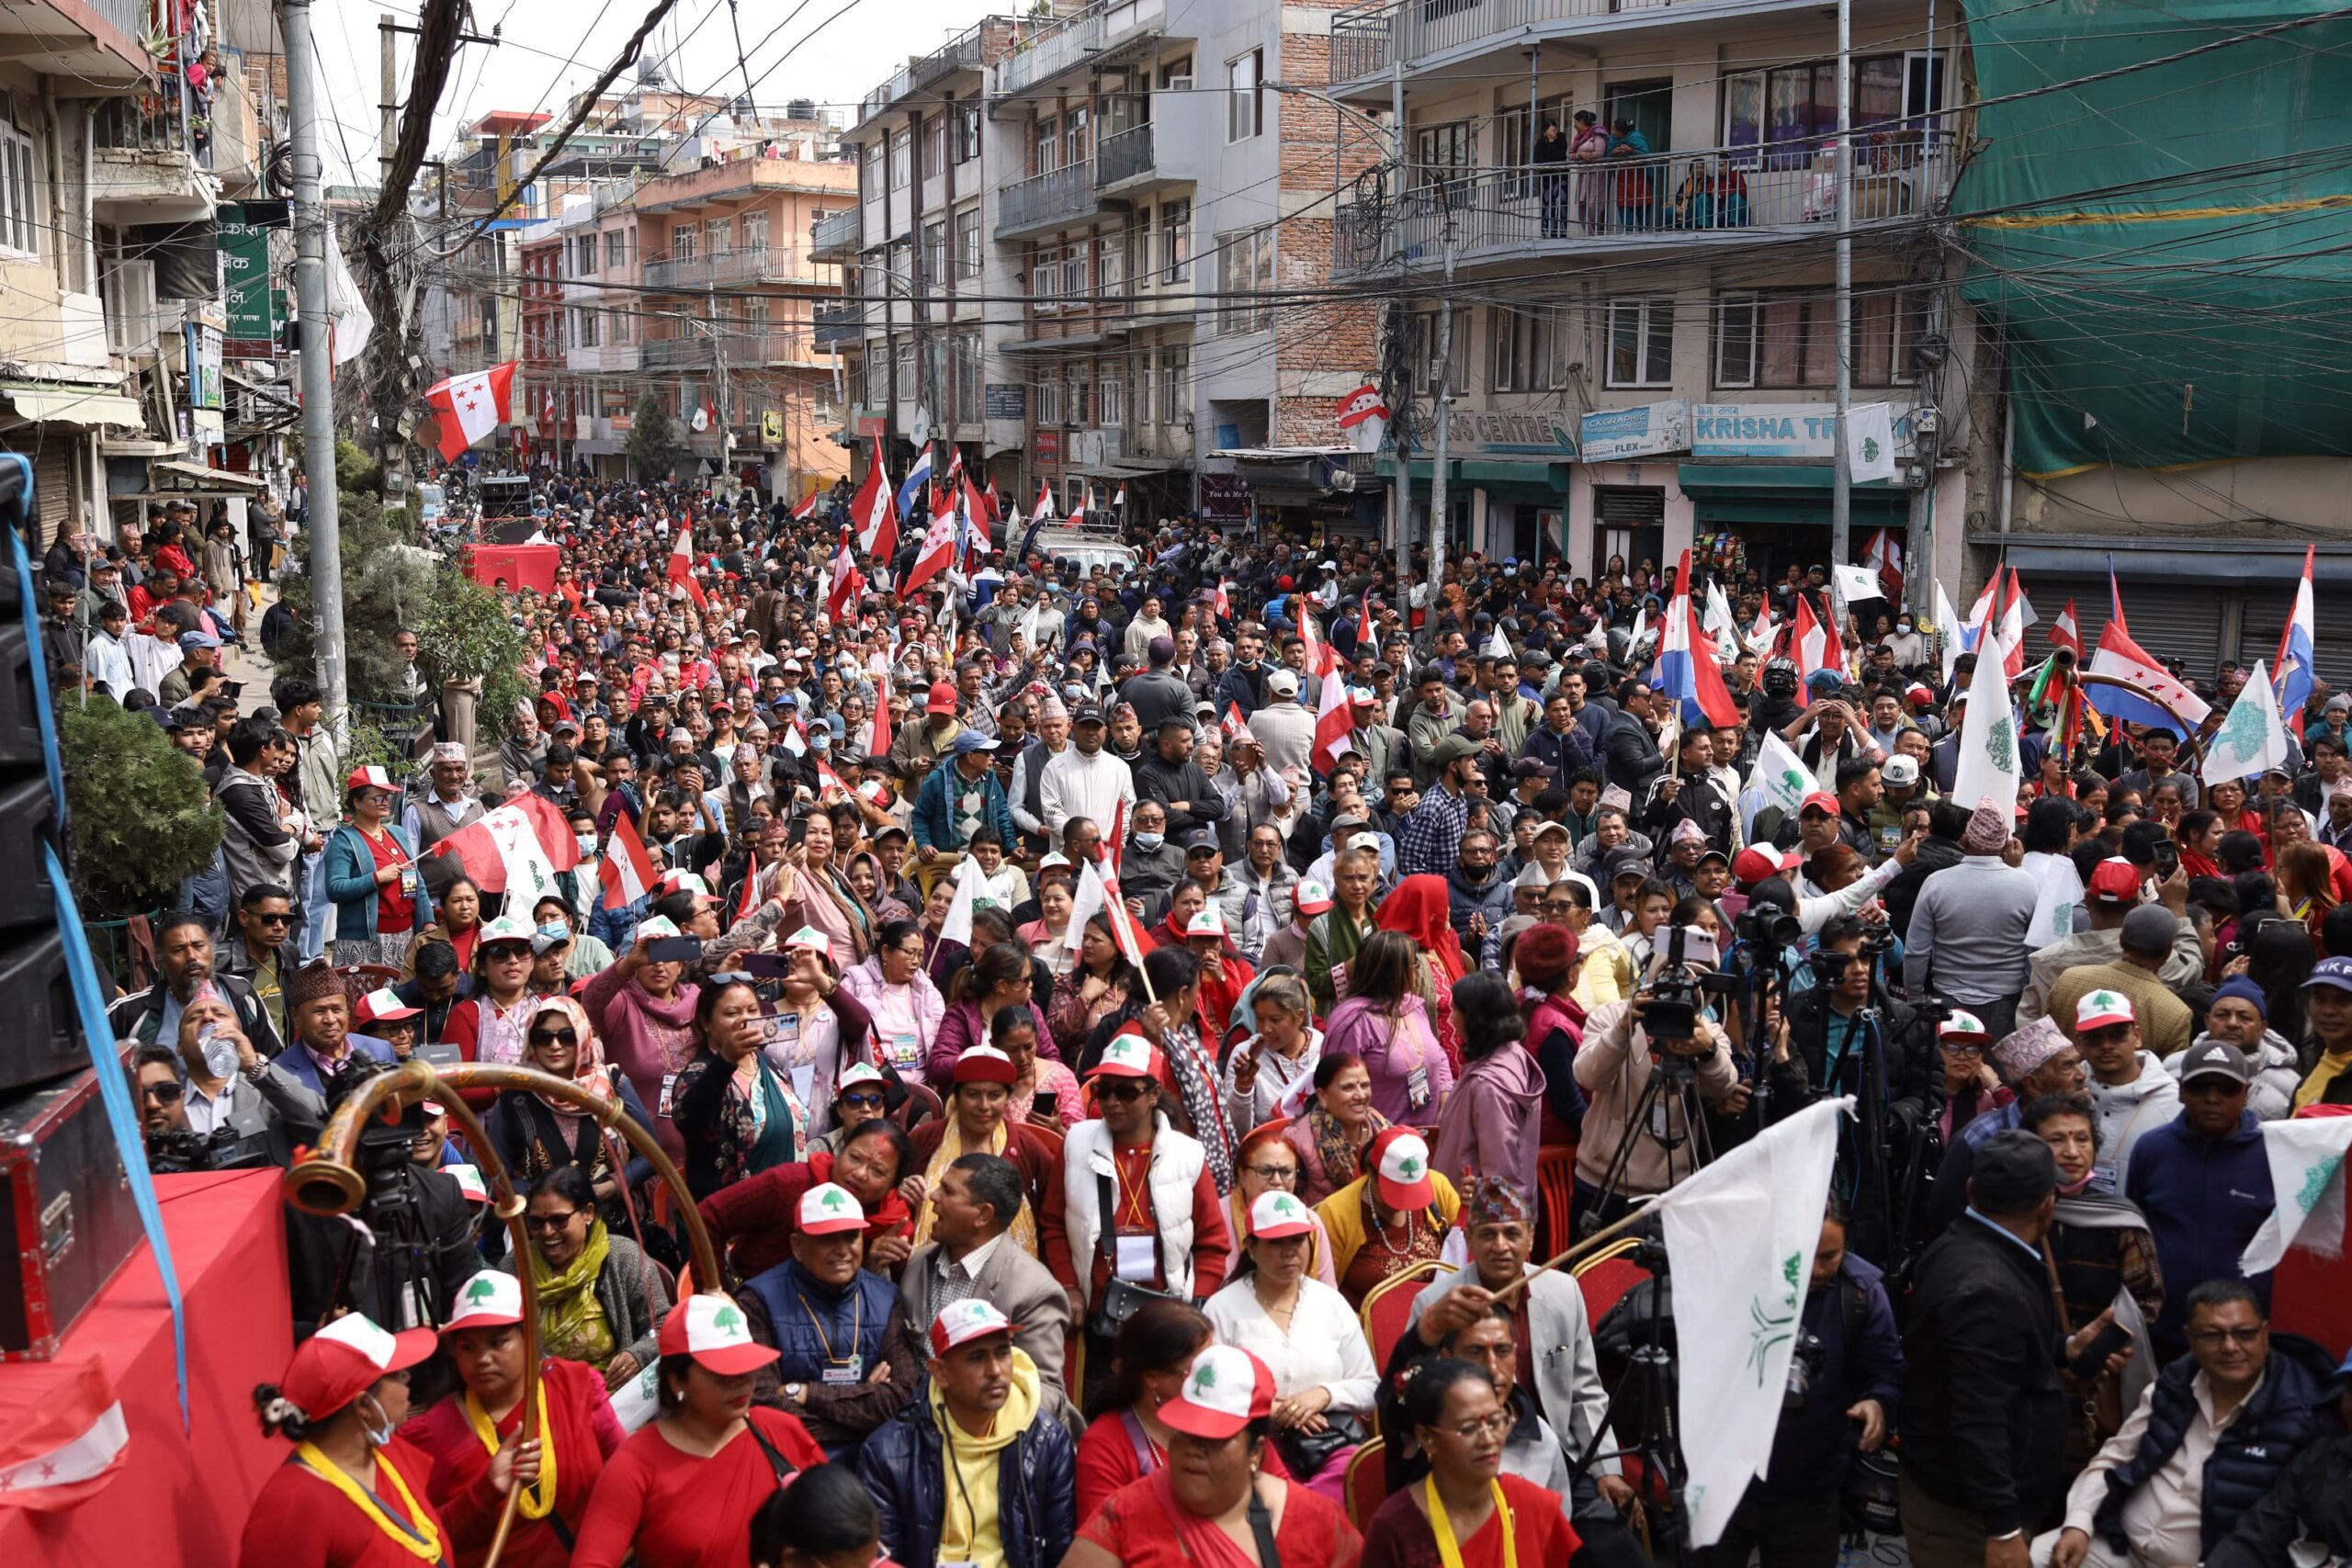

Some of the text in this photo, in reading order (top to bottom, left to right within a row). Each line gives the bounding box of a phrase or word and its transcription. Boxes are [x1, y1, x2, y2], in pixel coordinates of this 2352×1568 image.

[1476, 416, 1555, 443] CENTRE
[1697, 417, 1797, 440] KRISHA
[1615, 443, 1638, 453] FLEX
